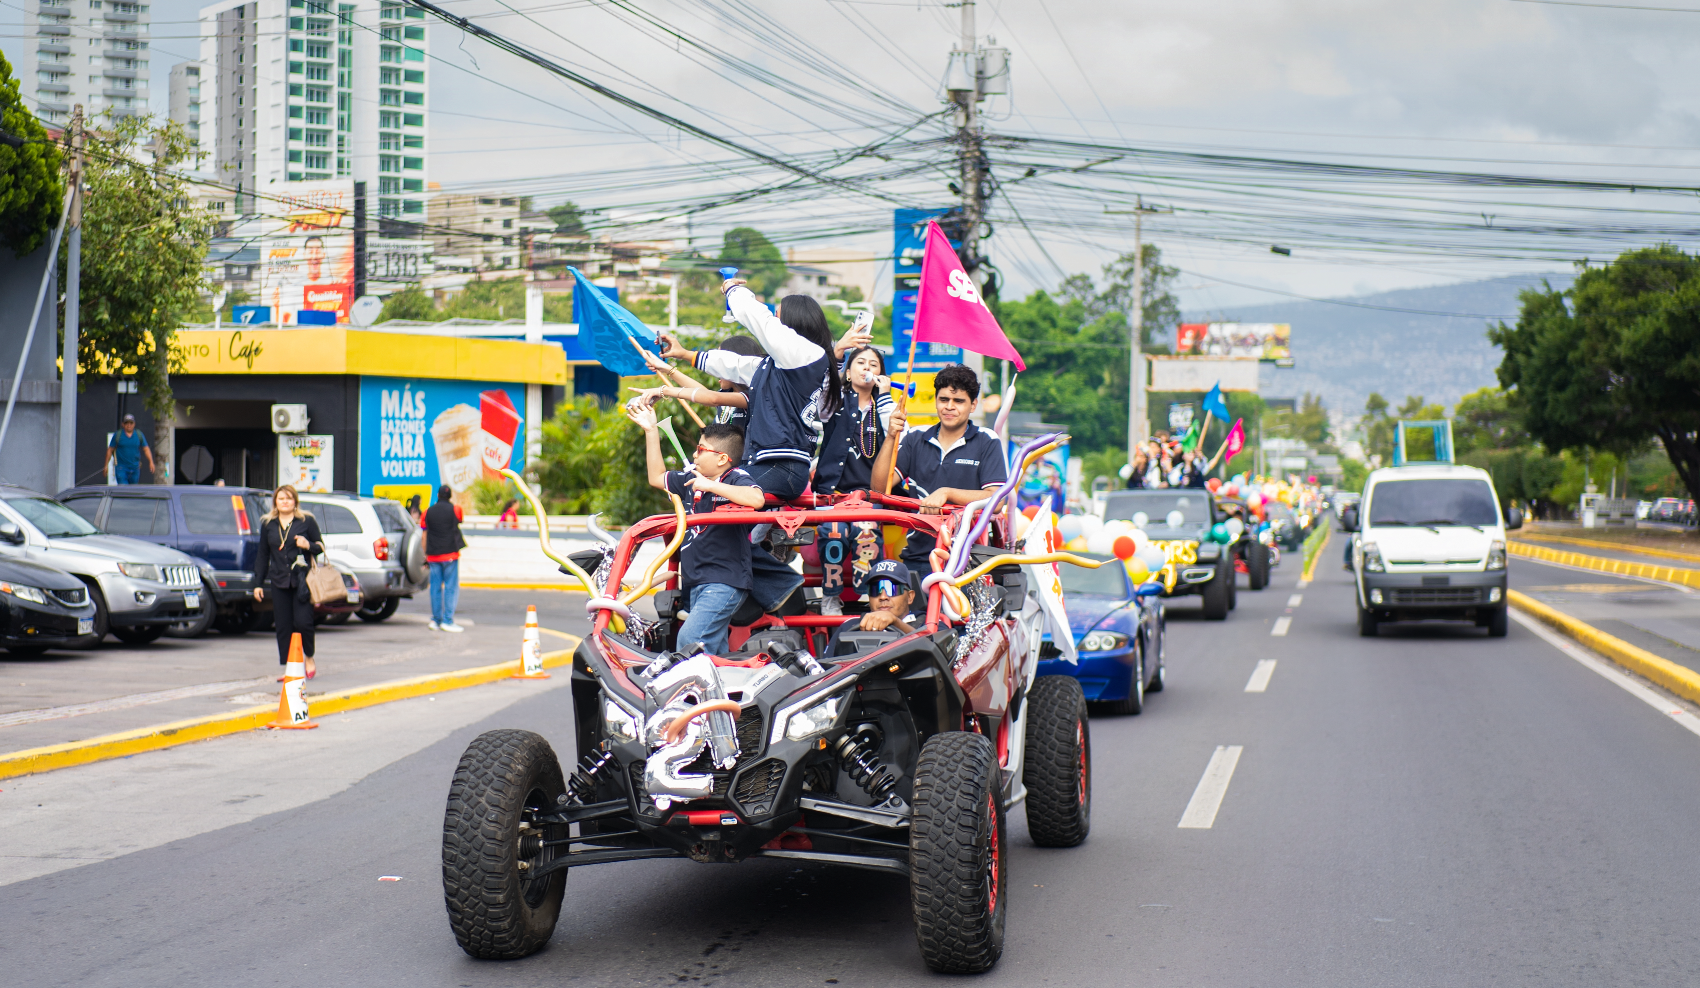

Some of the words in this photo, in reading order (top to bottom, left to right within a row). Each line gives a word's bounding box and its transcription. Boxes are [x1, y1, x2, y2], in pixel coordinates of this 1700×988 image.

[947, 269, 990, 313] SE
[229, 330, 263, 369] Café
[381, 383, 426, 419] MÁS
[381, 419, 426, 434] RAZONES
[380, 434, 426, 458] PARA
[380, 460, 426, 478] VOLVER
[876, 561, 898, 572] NY
